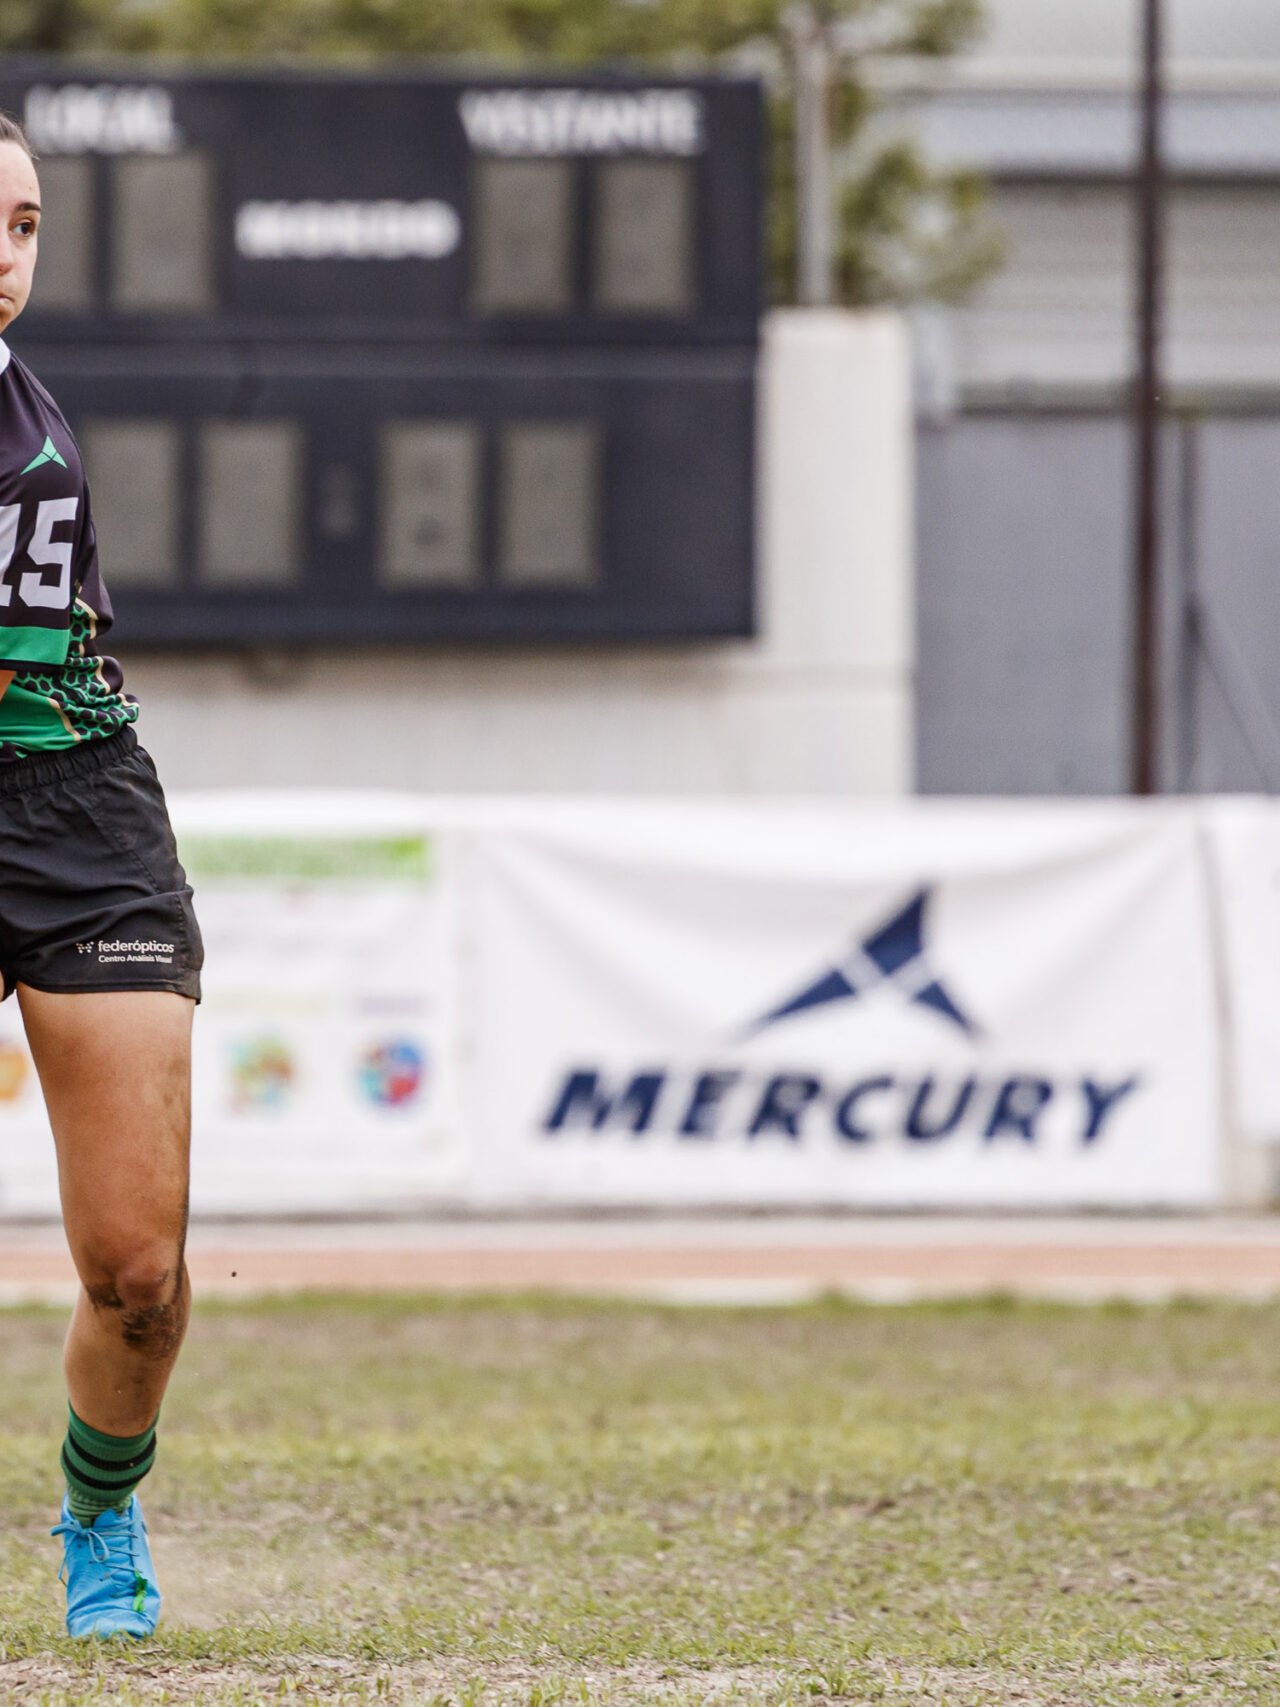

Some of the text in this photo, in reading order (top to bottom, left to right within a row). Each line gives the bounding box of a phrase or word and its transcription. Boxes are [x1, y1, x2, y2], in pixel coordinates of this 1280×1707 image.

[98, 940, 175, 954] federópticos
[98, 955, 126, 963] Centro
[542, 1066, 1140, 1146] MERCURY
